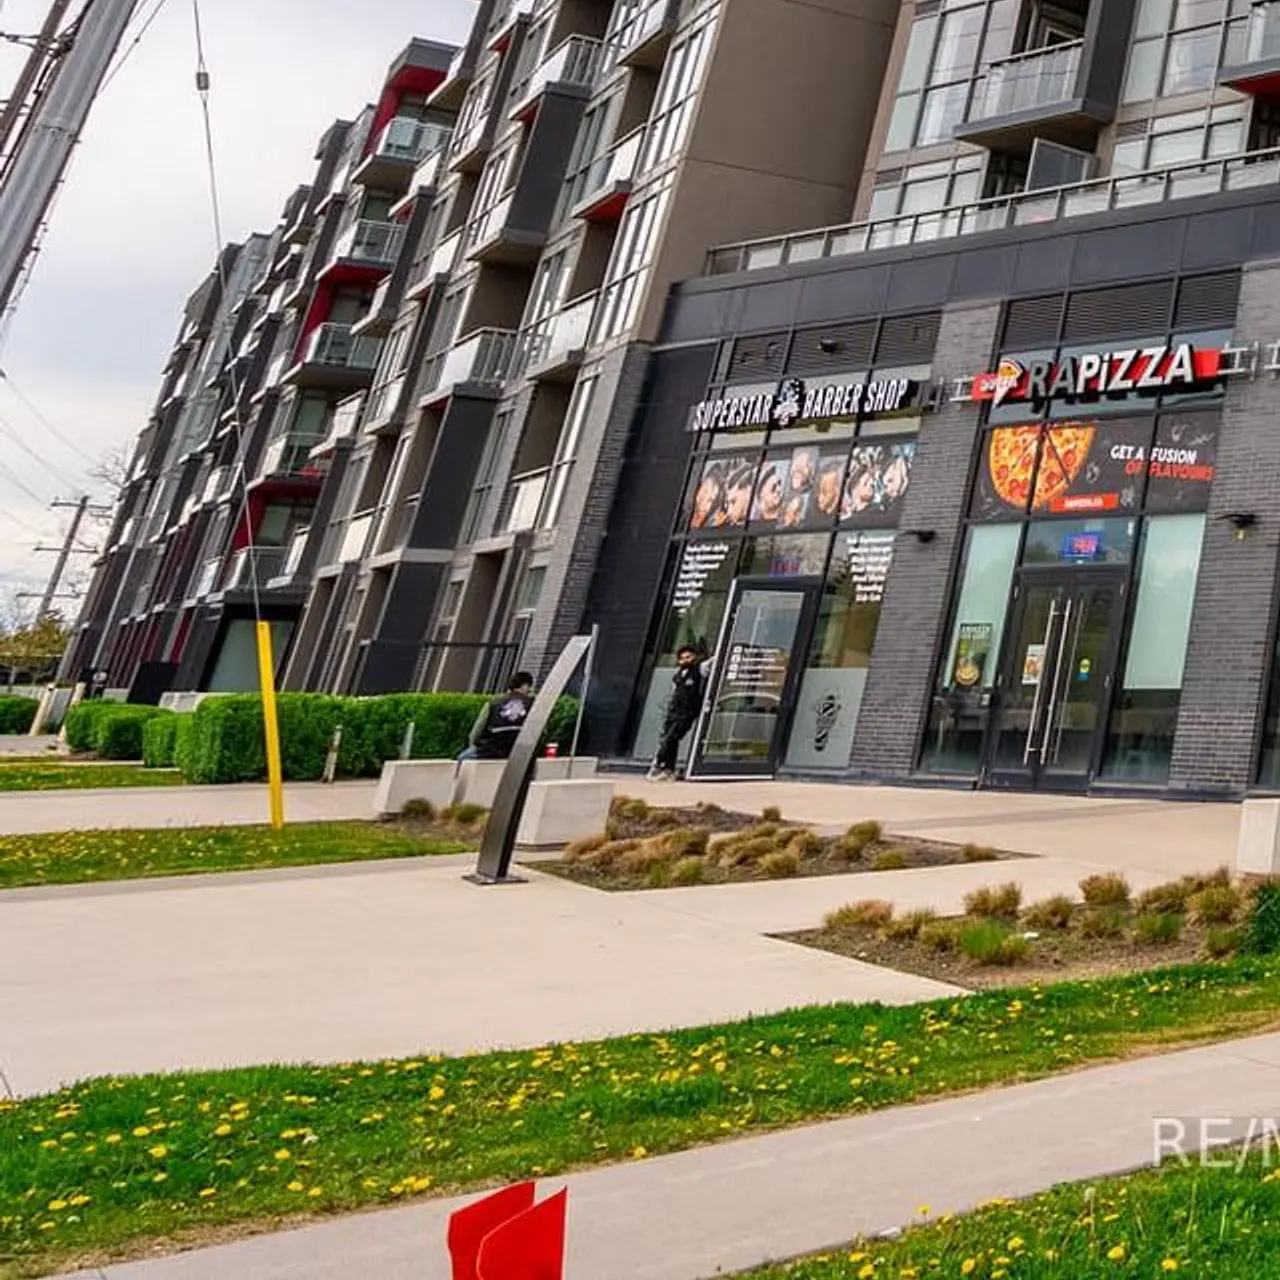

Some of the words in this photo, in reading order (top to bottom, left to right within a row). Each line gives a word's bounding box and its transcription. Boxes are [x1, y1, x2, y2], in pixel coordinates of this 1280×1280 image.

[692, 394, 774, 430] SUPERSTAR
[802, 384, 864, 418] BARBER
[864, 379, 909, 412] SHOP
[1110, 444, 1135, 460] GET
[1135, 446, 1145, 461] A
[1150, 447, 1197, 465] FUSION
[1125, 461, 1144, 476] OF
